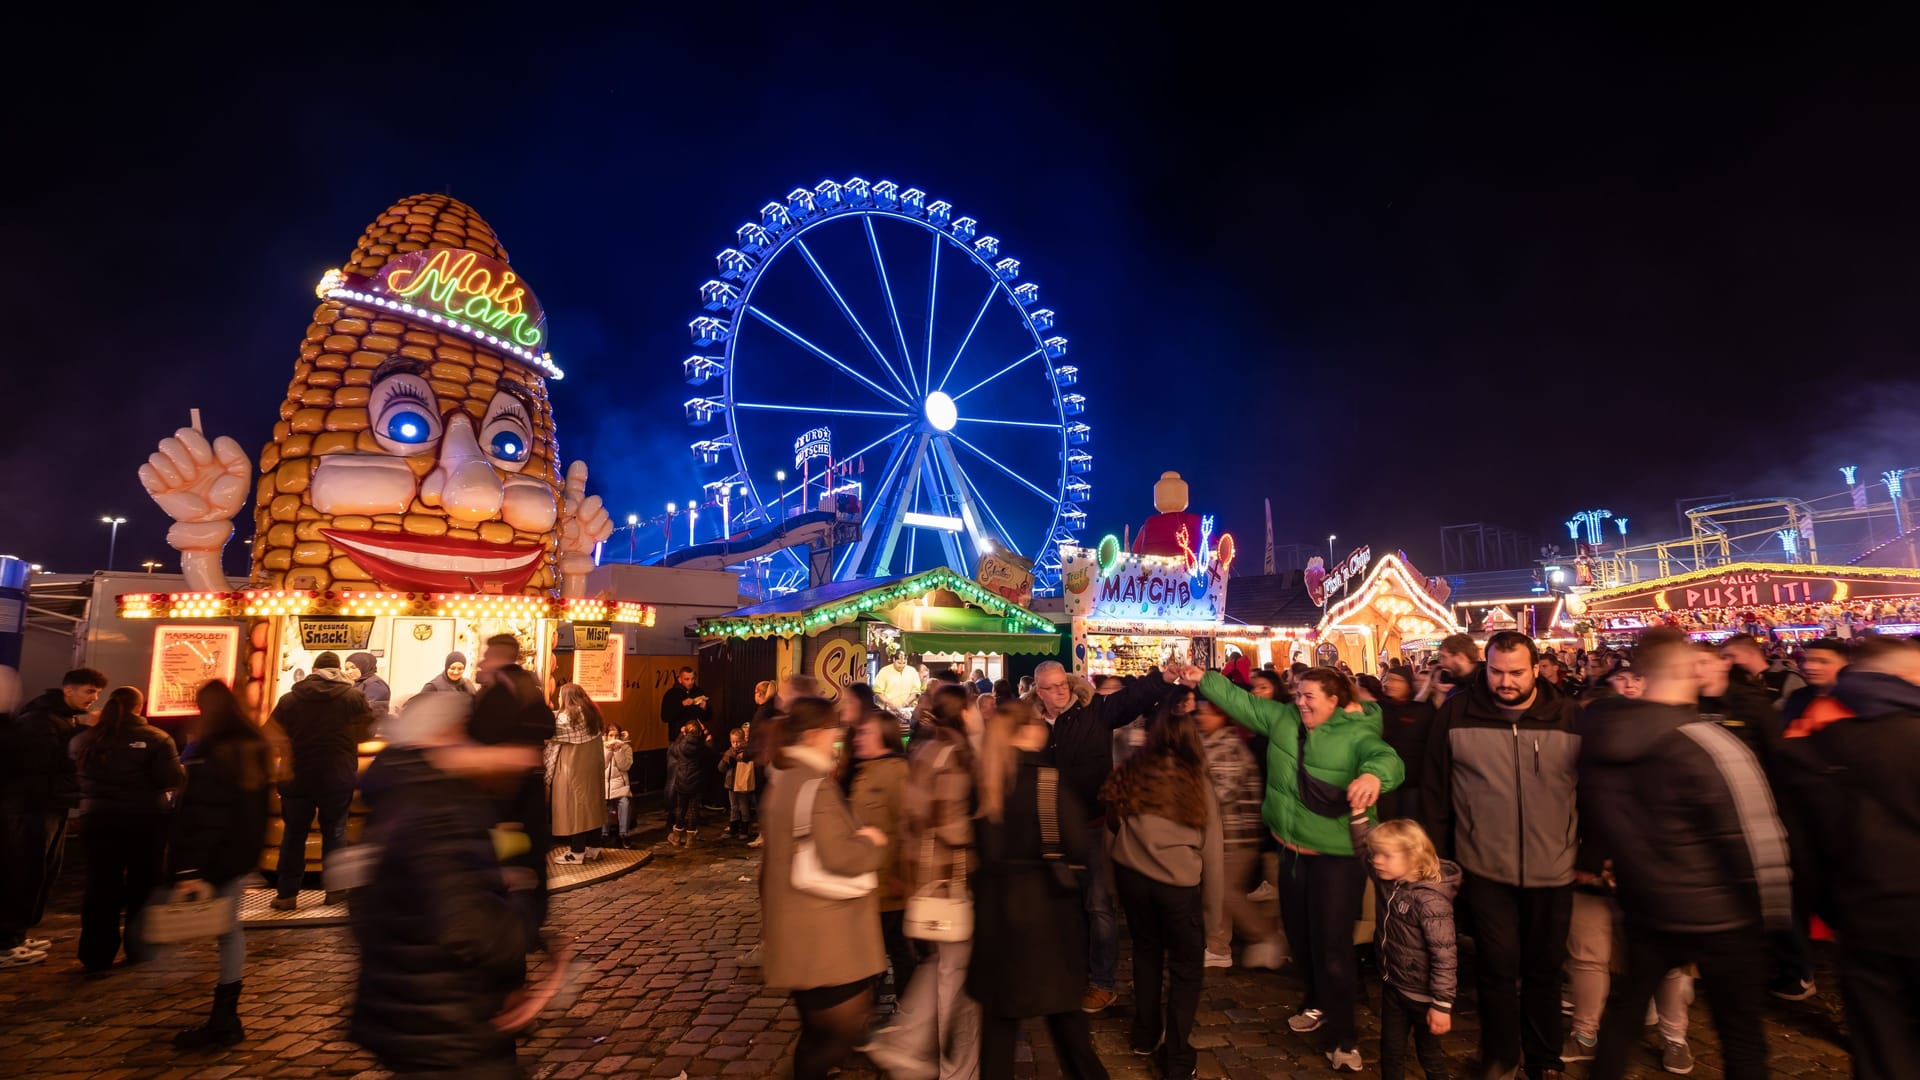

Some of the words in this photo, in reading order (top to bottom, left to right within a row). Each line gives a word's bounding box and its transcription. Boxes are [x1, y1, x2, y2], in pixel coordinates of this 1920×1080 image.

[388, 250, 525, 316] Mais
[400, 268, 541, 345] Man
[1719, 573, 1770, 585] GALLE'S
[1686, 584, 1758, 607] PUSH
[1772, 581, 1811, 603] IT!
[305, 630, 348, 644] Snack!
[318, 623, 349, 631] gesunde
